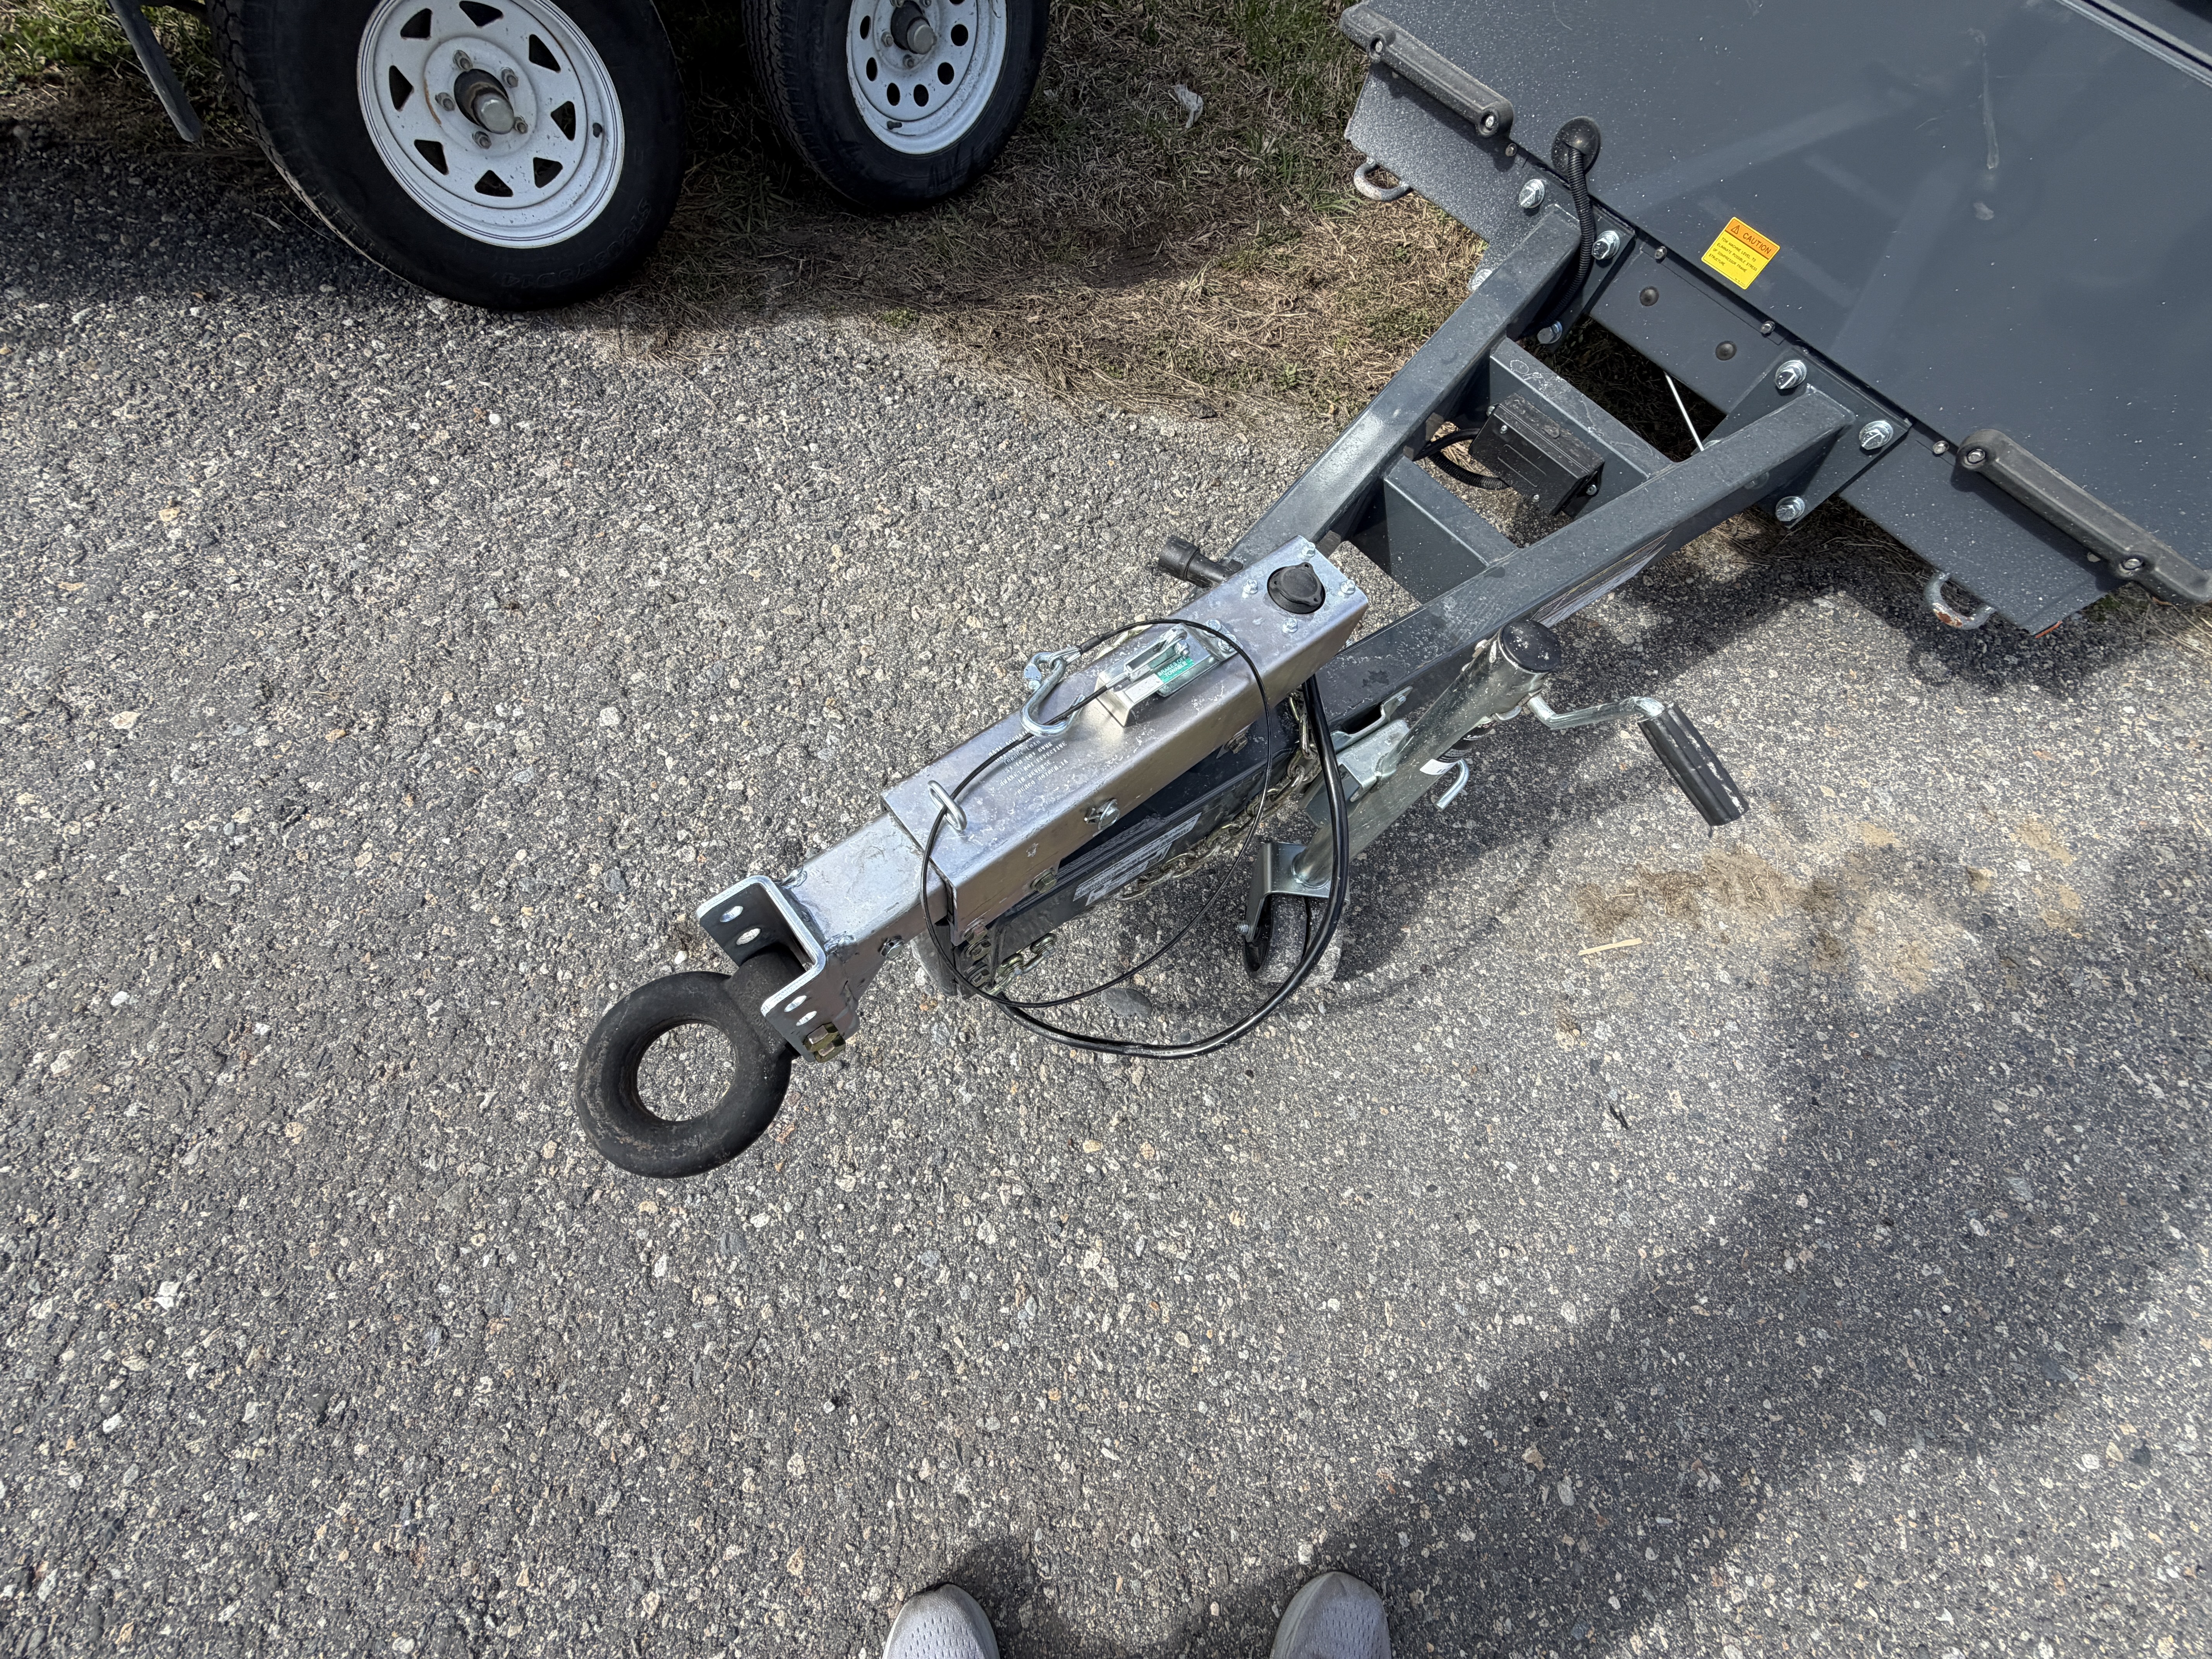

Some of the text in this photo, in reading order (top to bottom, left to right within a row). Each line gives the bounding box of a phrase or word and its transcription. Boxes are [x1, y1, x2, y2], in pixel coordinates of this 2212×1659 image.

[1729, 242, 1741, 252] MACHINE
[1741, 251, 1750, 259] LEVEL
[1743, 233, 1772, 254] CAUTION
[1709, 253, 1726, 266] STRUCTURE
[1717, 243, 1758, 271] ELIMINATE POSSIBLE STRESS
[1717, 251, 1737, 265] COMPRESSOR
[1736, 264, 1747, 273] FRAME
[1157, 655, 1186, 677] BRAKES OFF
[1164, 661, 1188, 677] TOWABLE
